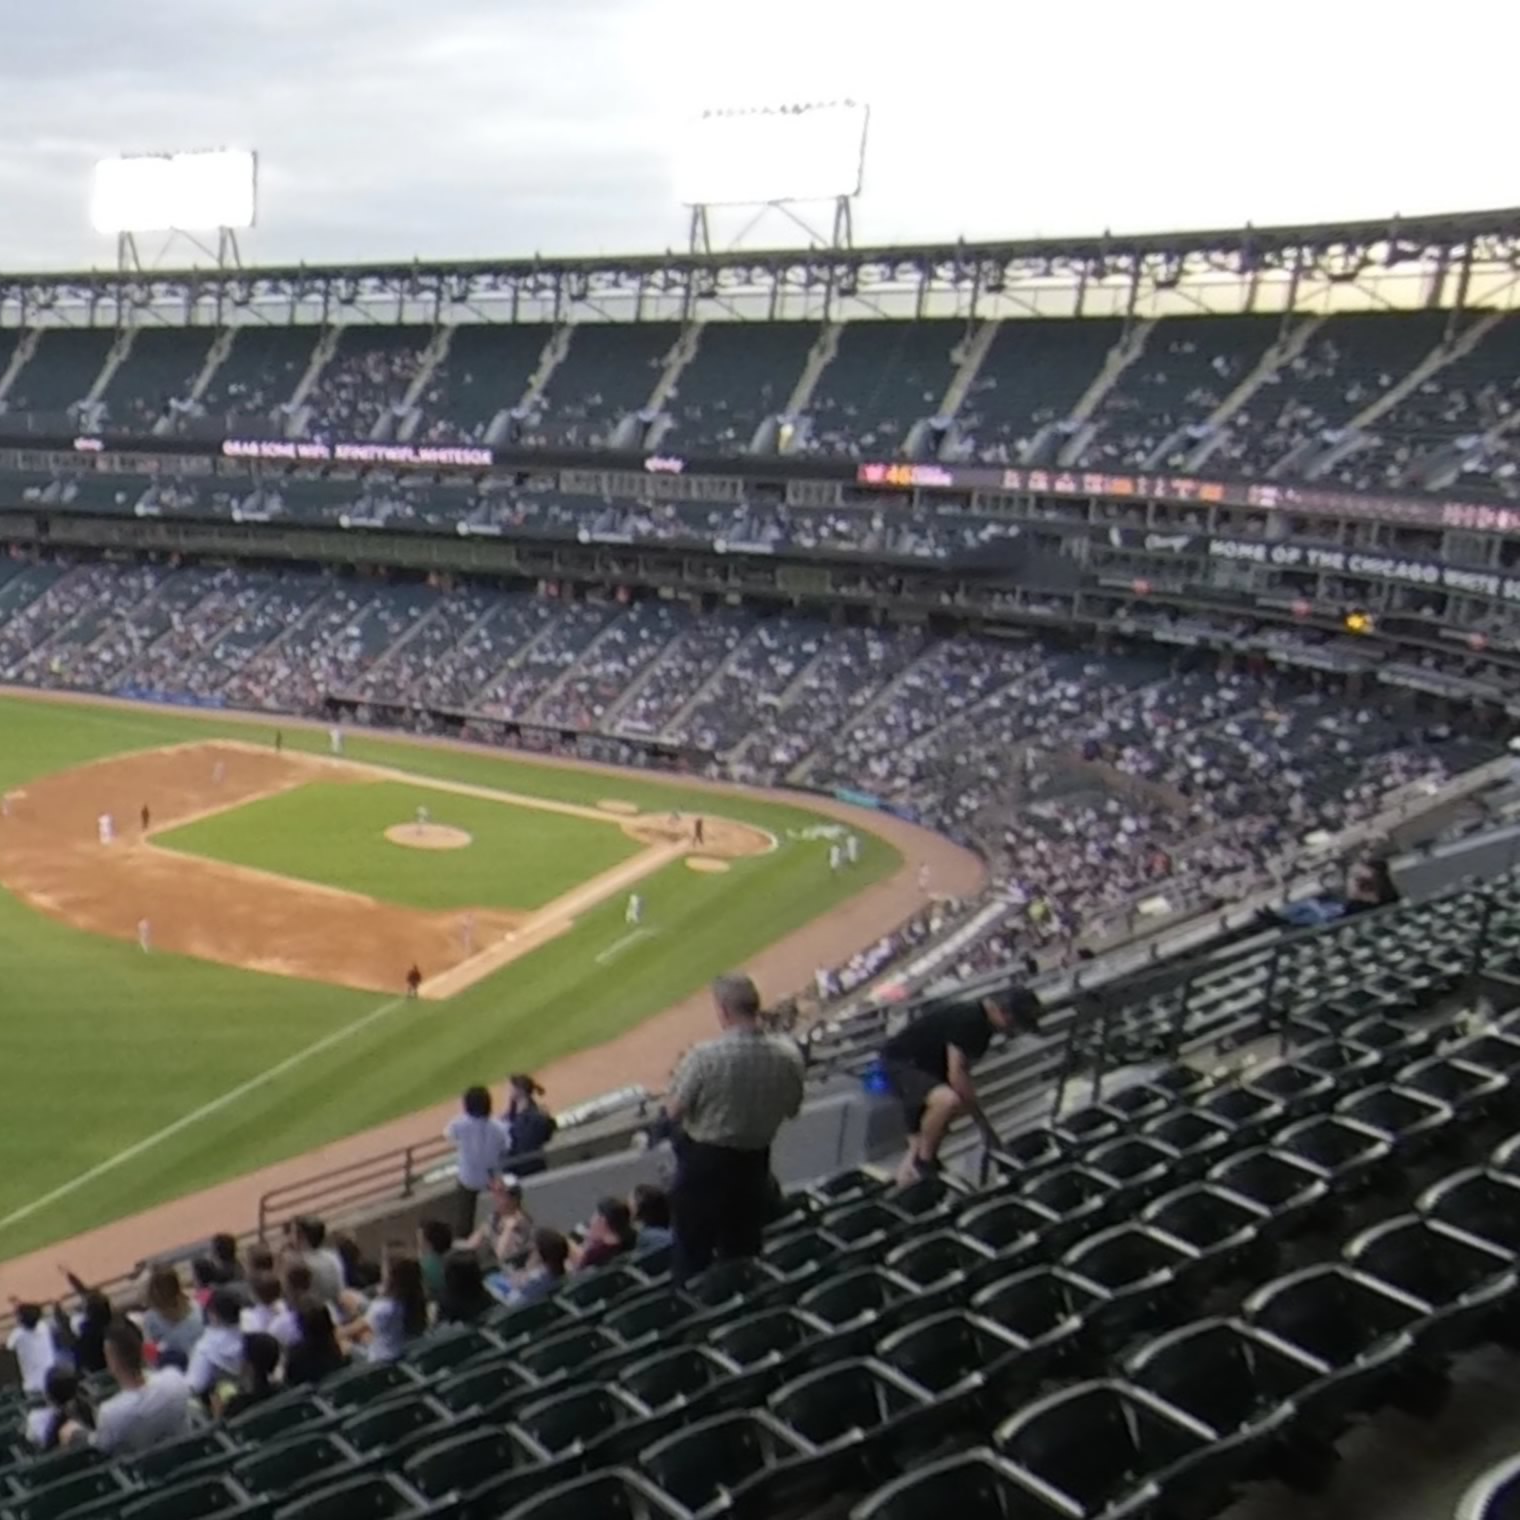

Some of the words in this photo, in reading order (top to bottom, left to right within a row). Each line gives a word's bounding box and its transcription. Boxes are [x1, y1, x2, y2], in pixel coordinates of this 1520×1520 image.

[222, 440, 259, 456] GRAB
[260, 441, 296, 458] SOME
[1210, 539, 1267, 561] HOME
[1270, 544, 1301, 565] OF
[1306, 549, 1345, 570] THE
[1348, 554, 1439, 583] CHICAGO
